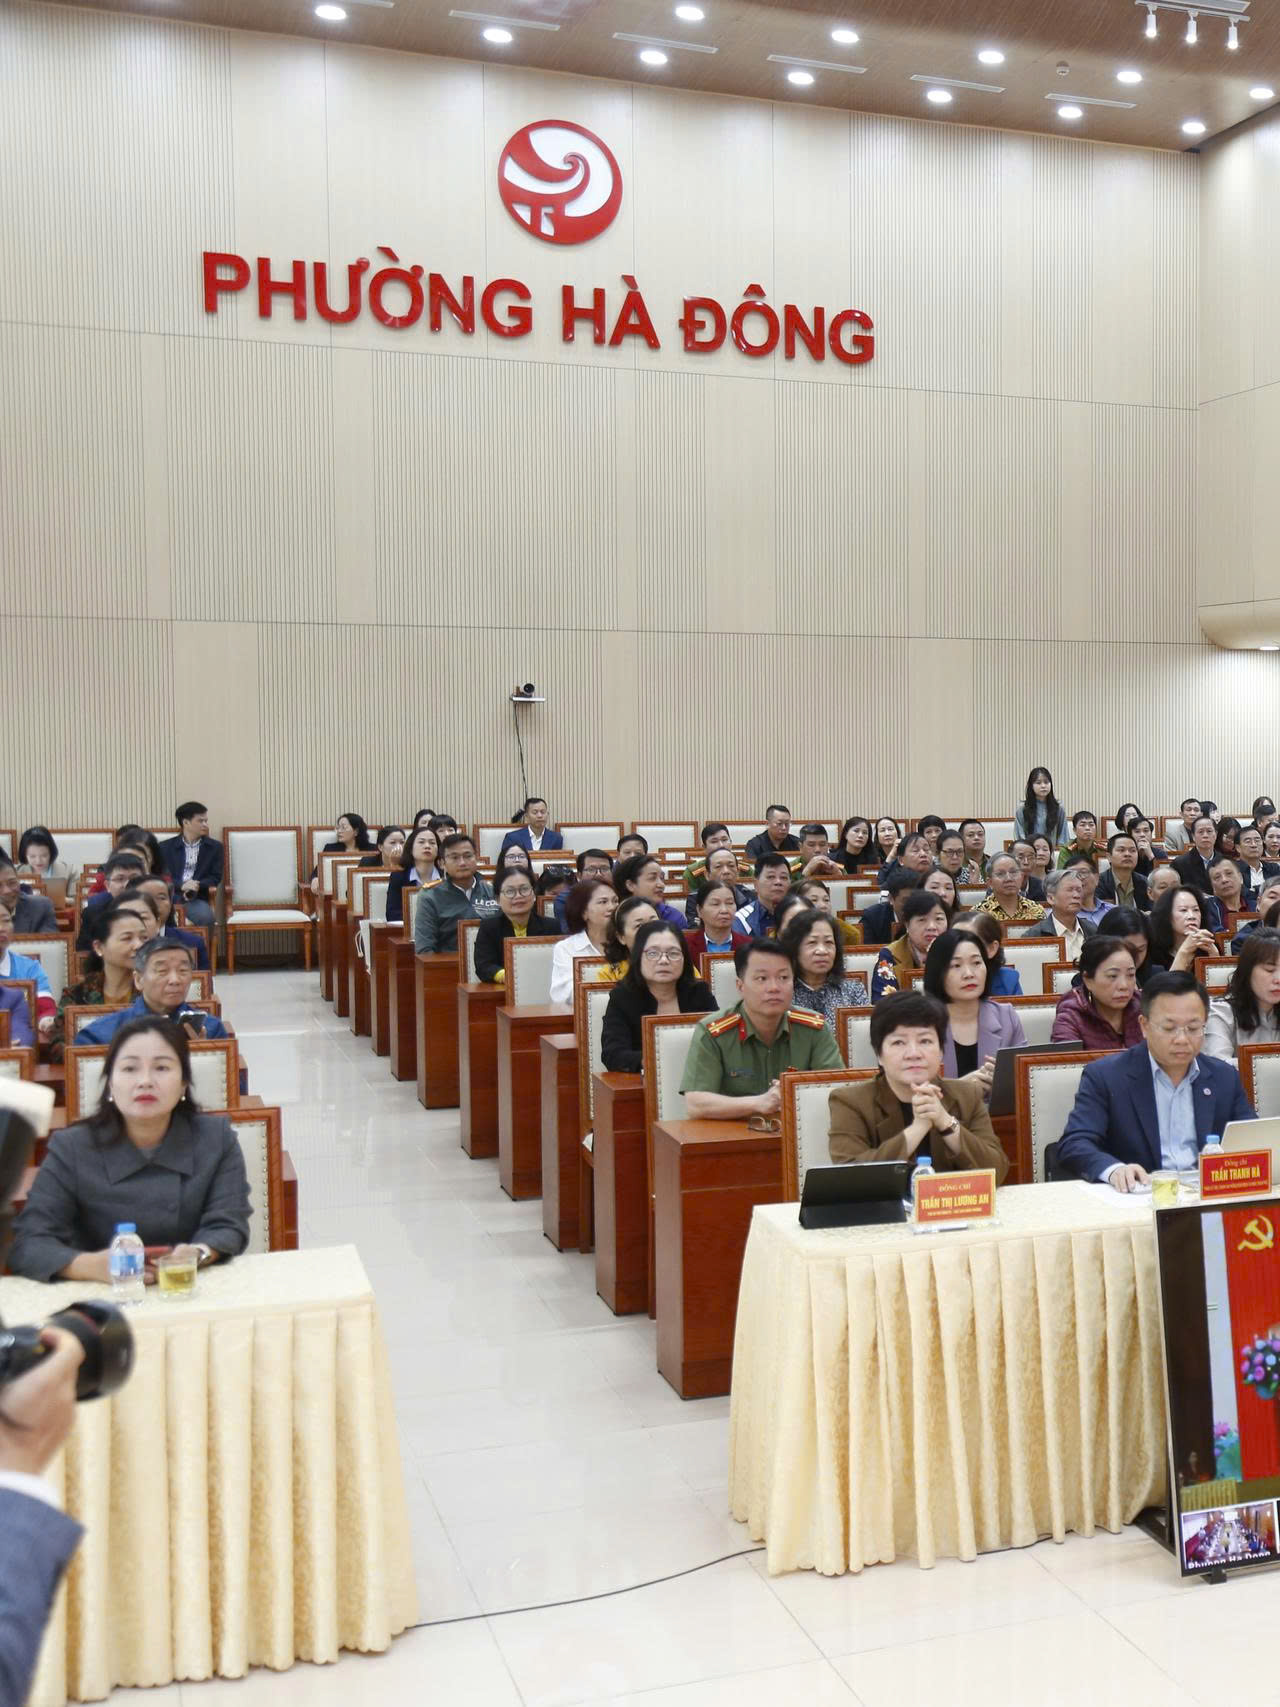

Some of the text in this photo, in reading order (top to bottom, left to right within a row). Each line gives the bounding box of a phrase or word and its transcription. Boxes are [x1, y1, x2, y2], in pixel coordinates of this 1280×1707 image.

[202, 246, 876, 365] PHƯỜNG HÀ ĐÔNG
[1229, 1167, 1251, 1180] THANH
